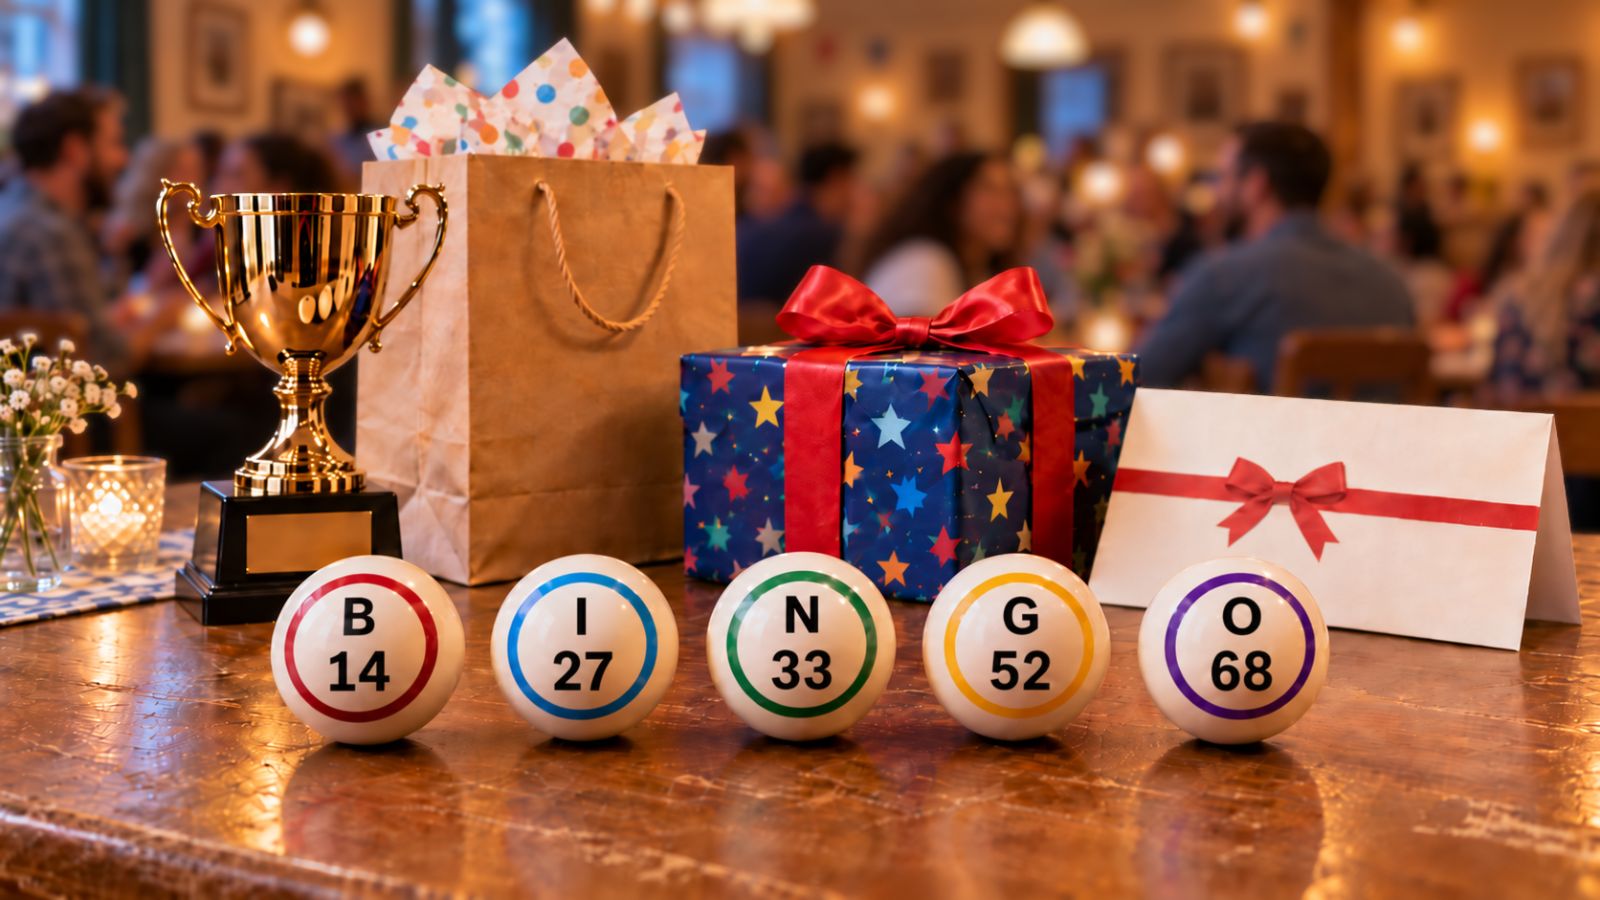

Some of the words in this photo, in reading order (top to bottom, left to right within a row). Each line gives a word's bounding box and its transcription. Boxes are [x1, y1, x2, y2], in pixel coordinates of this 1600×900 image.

[344, 598, 374, 635] B
[577, 598, 586, 635] I
[786, 596, 818, 633] N
[1003, 597, 1038, 635] G
[1223, 597, 1261, 635] O
[330, 651, 390, 691] 14
[554, 651, 612, 691] 27
[772, 650, 832, 690] 33
[991, 650, 1050, 690] 52
[1212, 651, 1272, 692] 68
